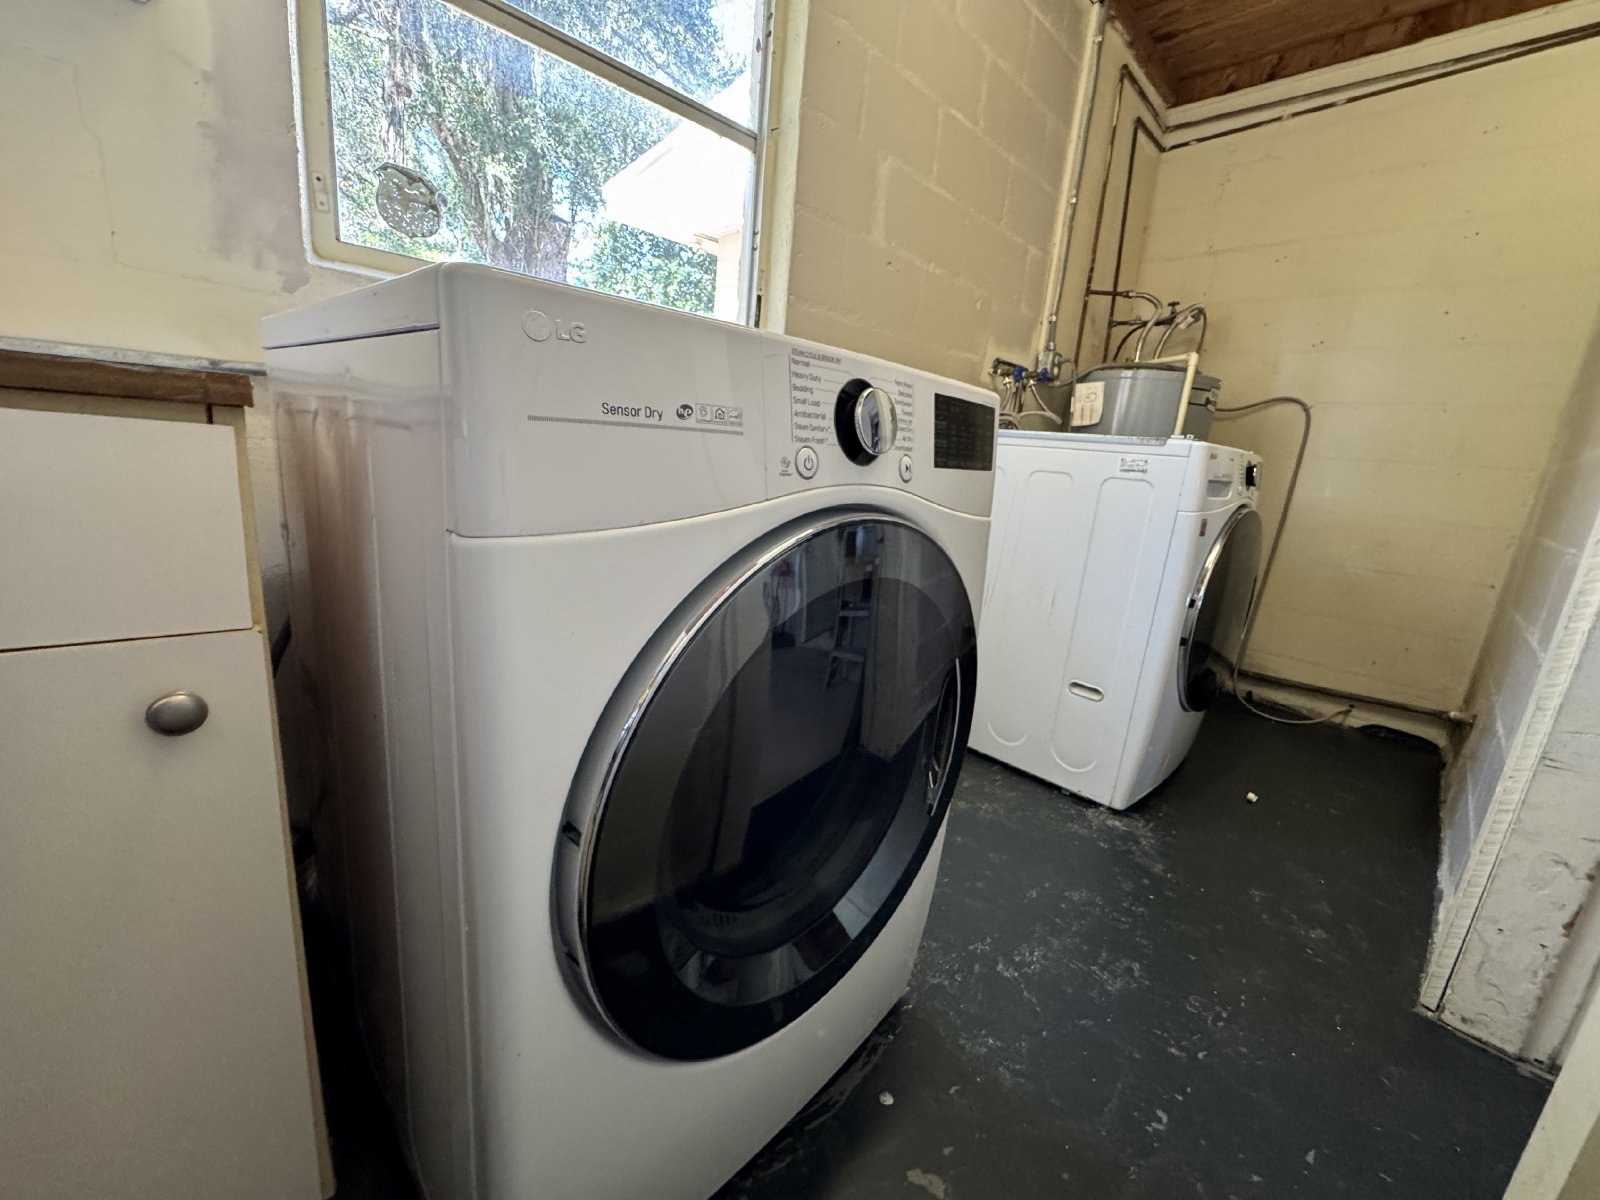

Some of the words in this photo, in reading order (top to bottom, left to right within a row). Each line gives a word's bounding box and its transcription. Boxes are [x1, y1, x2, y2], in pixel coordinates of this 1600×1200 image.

[555, 319, 586, 344] LG
[601, 402, 642, 418] Sensor
[644, 406, 663, 422] Dry
